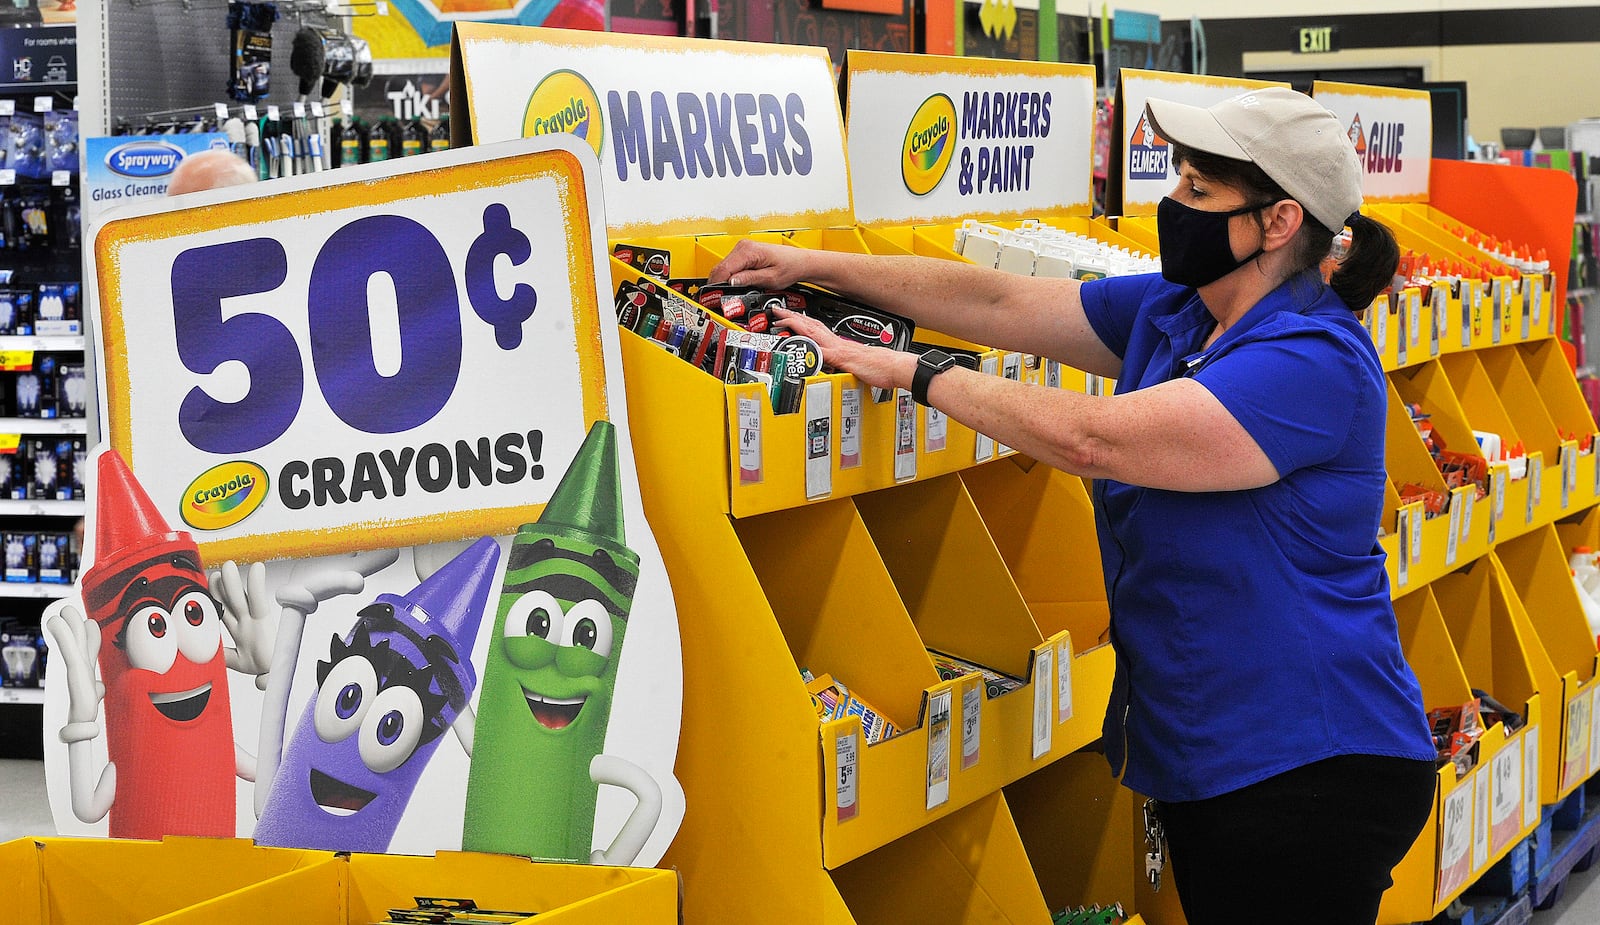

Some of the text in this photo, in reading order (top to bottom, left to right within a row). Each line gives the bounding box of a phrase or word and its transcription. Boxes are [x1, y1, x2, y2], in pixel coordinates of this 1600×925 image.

[1300, 27, 1332, 53] EXIT
[534, 97, 586, 137] Crayola
[961, 91, 1052, 140] MARKERS
[607, 90, 813, 182] MARKERS
[911, 115, 947, 153] Crayola
[1367, 121, 1405, 175] GLUE
[118, 152, 177, 170] Sprayway
[958, 145, 1035, 196] & PAINT
[1130, 150, 1168, 173] ELMER'S
[92, 182, 169, 202] Glass Cleaner
[864, 319, 881, 331] LEVEL
[785, 344, 799, 377] Note!
[796, 343, 807, 374] Take
[194, 429, 545, 510] Crayola CRAYONS!
